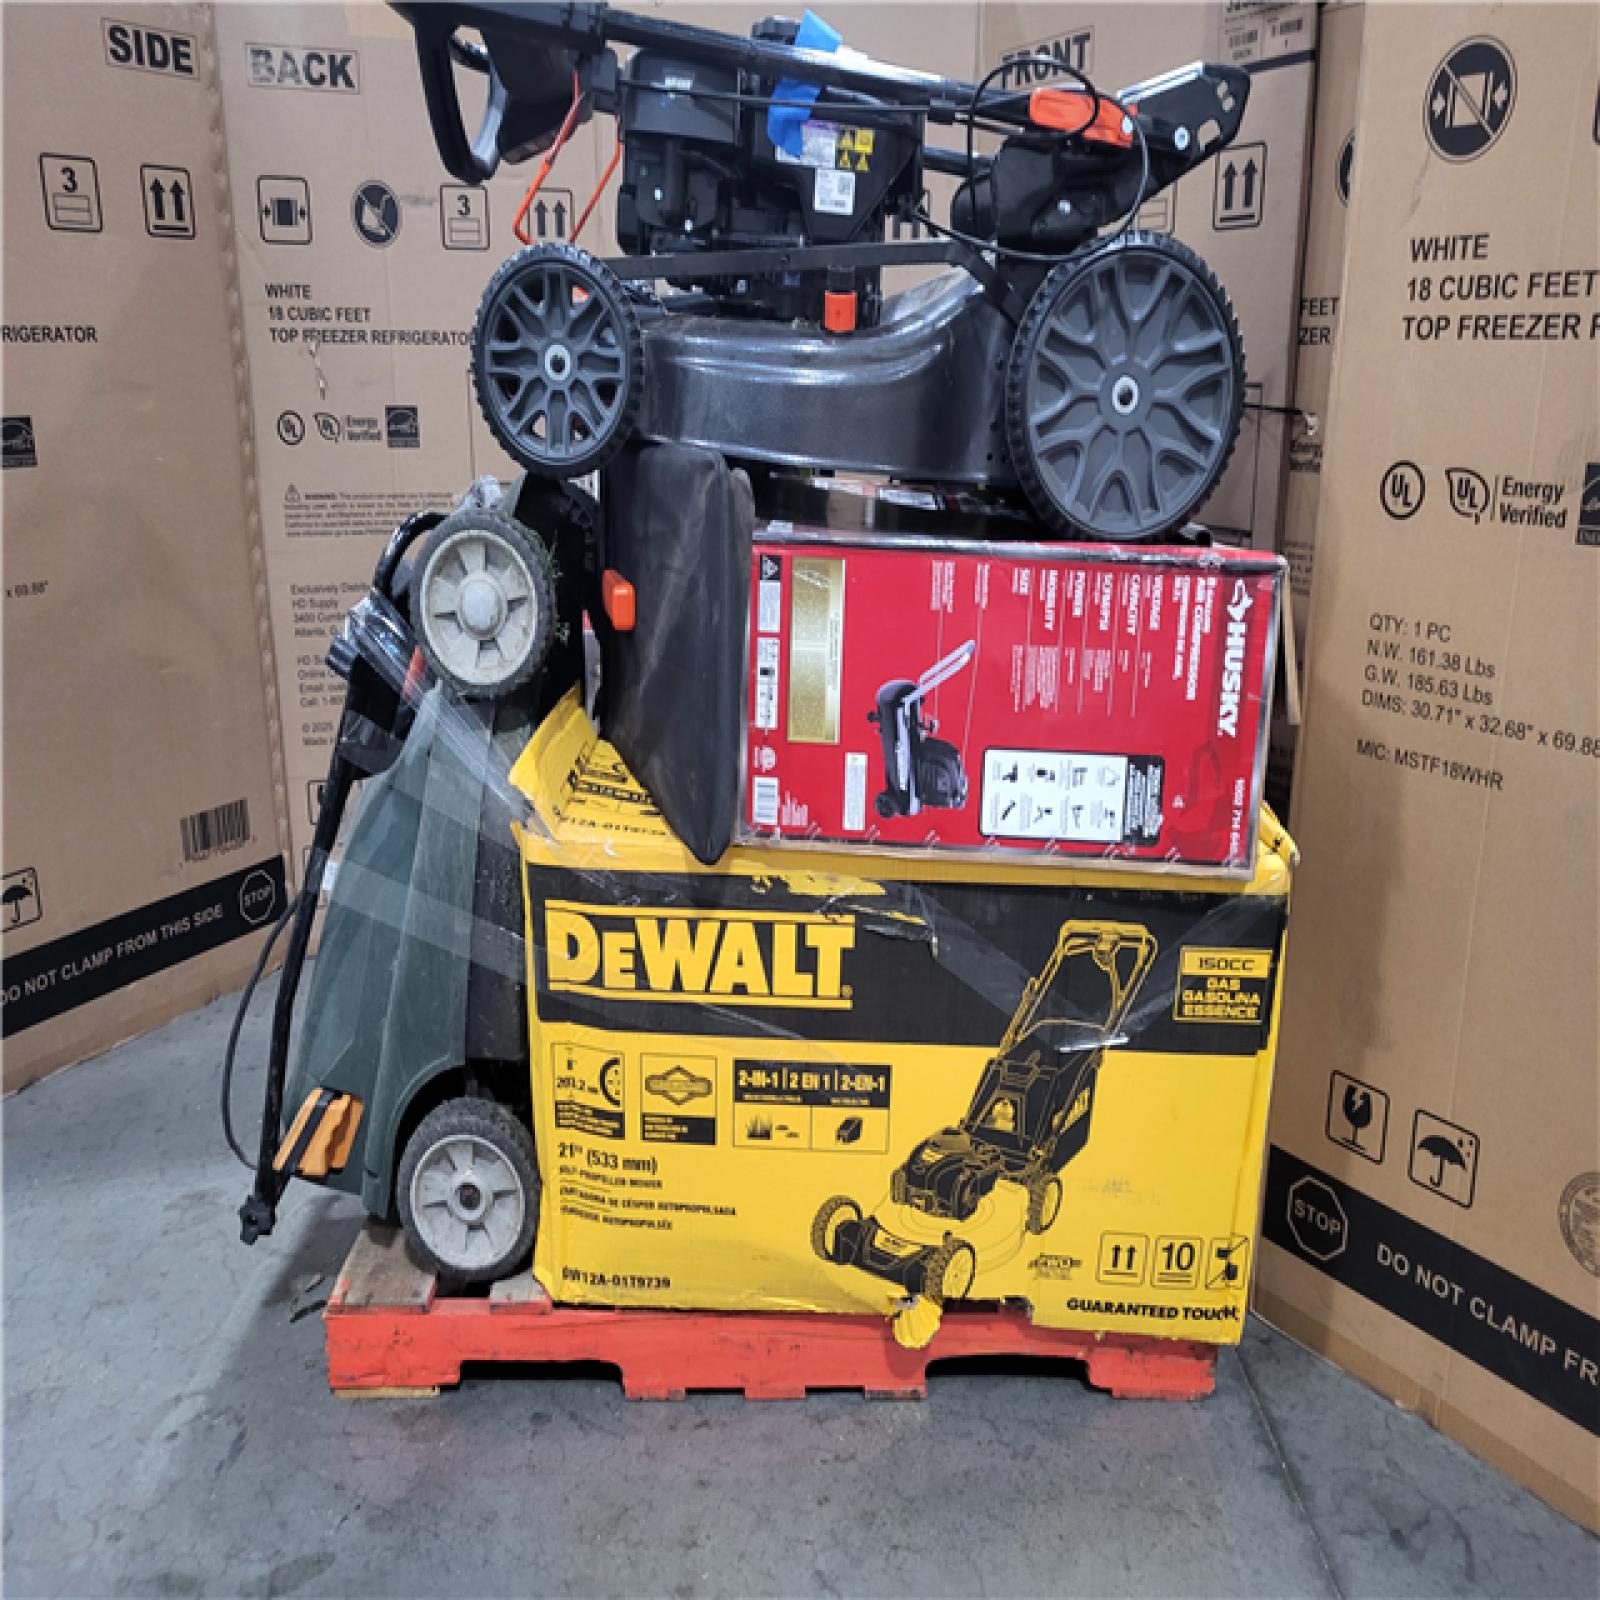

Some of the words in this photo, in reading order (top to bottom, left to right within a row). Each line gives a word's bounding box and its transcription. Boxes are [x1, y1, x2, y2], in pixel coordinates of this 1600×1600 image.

[108, 24, 194, 75] SIDE
[1002, 30, 1091, 88] FRONT
[250, 48, 355, 89] BACK
[62, 166, 77, 193] 3
[456, 194, 471, 216] 3
[1410, 232, 1490, 263] WHITE
[264, 284, 311, 299] WHITE
[1407, 277, 1432, 302] 18
[1439, 272, 1519, 301] CUBIC
[1527, 269, 1600, 298] FEET
[287, 307, 333, 321] CUBIC
[335, 307, 371, 322] FEET
[1402, 315, 1451, 340] TOP
[1457, 312, 1582, 341] FREEZER
[269, 327, 298, 343] TOP
[302, 328, 368, 344] FREEZER
[1502, 475, 1565, 505] Energy
[1500, 502, 1567, 528] Verified
[1369, 611, 1408, 636] QTY:
[1414, 620, 1421, 638] 1
[1427, 622, 1451, 643] PC
[1366, 639, 1403, 660] N.W.
[1409, 646, 1461, 672] 161.38
[1465, 656, 1496, 678] Lbs
[1218, 622, 1247, 738] HUSKY
[1364, 664, 1400, 686] G.W.
[1407, 672, 1459, 699] 185.63
[1462, 682, 1493, 706] Lbs
[1362, 689, 1406, 715] DIMS:
[1464, 717, 1475, 730] x
[1537, 730, 1548, 746] x
[1357, 738, 1391, 763] MIC:
[1394, 747, 1504, 791] MSTF18WHR
[244, 885, 272, 908] STOP
[25, 969, 57, 996] NOT
[61, 946, 113, 981] CLAMP
[117, 928, 158, 959] FROM
[160, 916, 192, 941] THIS
[194, 902, 224, 928] SIDE
[1294, 1199, 1341, 1237] STOP
[1162, 1241, 1195, 1271] 10
[1066, 1297, 1179, 1320] GUARANTEED
[1376, 1242, 1410, 1276] DO
[1415, 1263, 1466, 1306] NOT
[1469, 1296, 1556, 1356] CLAMP
